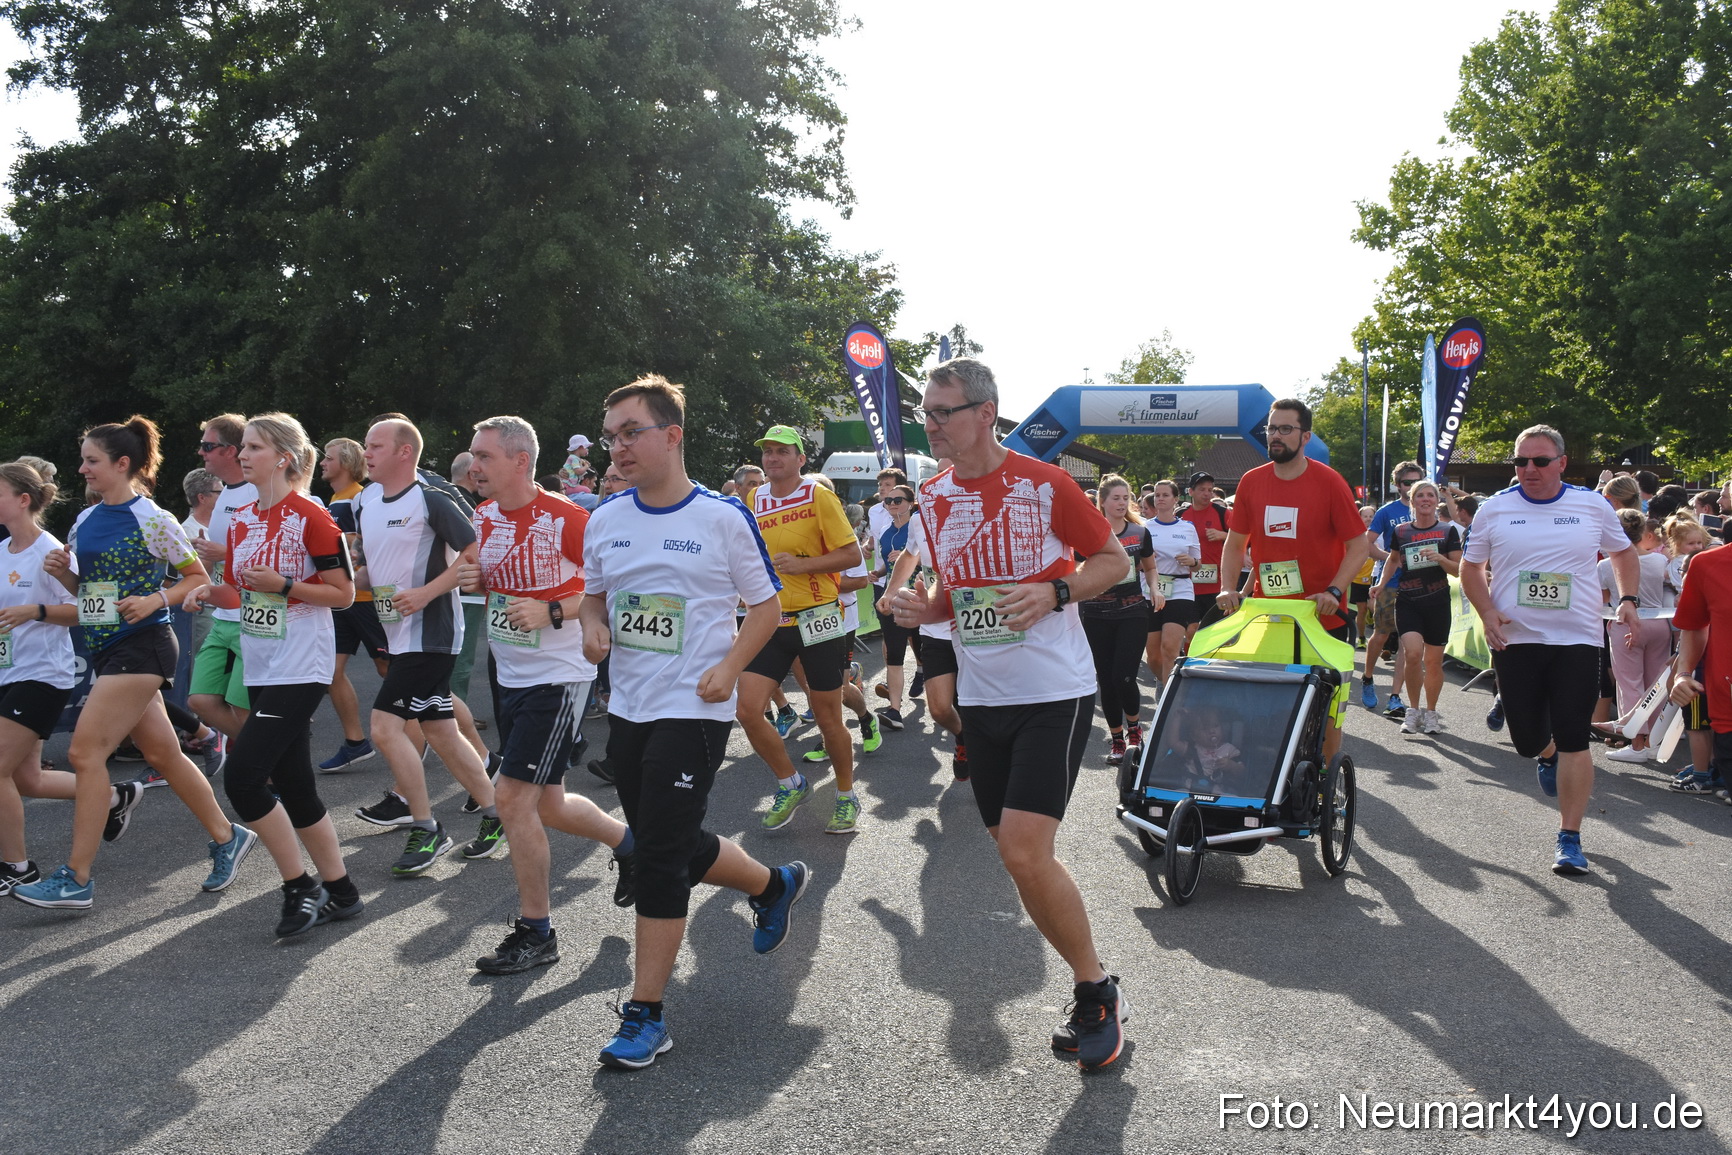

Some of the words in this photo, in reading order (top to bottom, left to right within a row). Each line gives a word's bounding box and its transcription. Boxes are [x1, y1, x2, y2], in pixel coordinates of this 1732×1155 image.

[1445, 338, 1478, 360] Hervis
[1140, 409, 1199, 421] firmenlauf
[1029, 428, 1061, 436] Fischer
[782, 508, 816, 524] BÖGL
[1554, 516, 1580, 525] GOSSNER
[611, 540, 631, 549] JAKO
[663, 539, 702, 555] GOSSNER
[1267, 573, 1290, 588] 501
[1529, 584, 1559, 599] 933
[82, 598, 106, 613] 202
[243, 605, 278, 626] 2226
[621, 611, 673, 638] 2443
[805, 616, 839, 635] 1669
